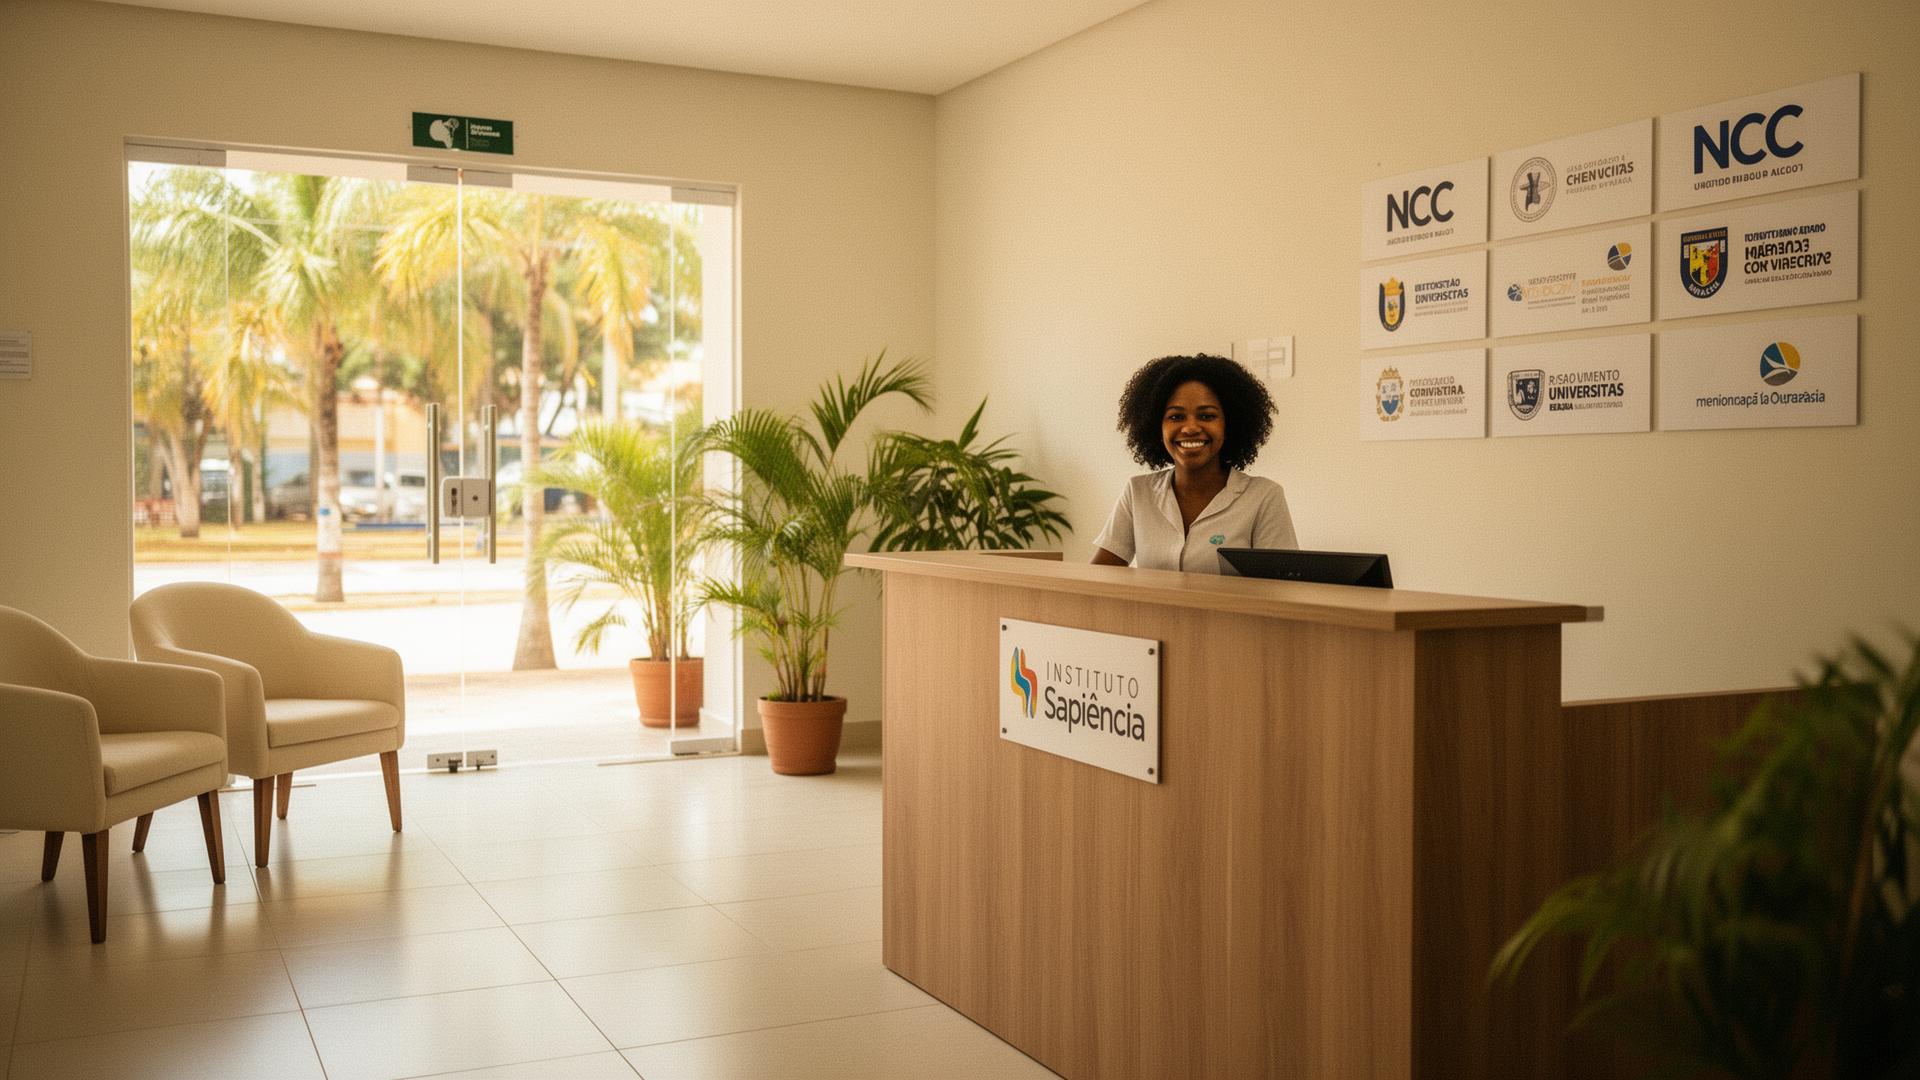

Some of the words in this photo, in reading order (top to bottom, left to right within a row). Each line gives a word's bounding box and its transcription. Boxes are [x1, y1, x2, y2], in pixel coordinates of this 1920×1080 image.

[1694, 104, 1804, 175] NCC
[1387, 181, 1454, 232] NCC
[1549, 382, 1624, 400] UNIVERSITAS
[1046, 661, 1139, 699] INSTITUTO
[1044, 685, 1145, 742] Sapiência
